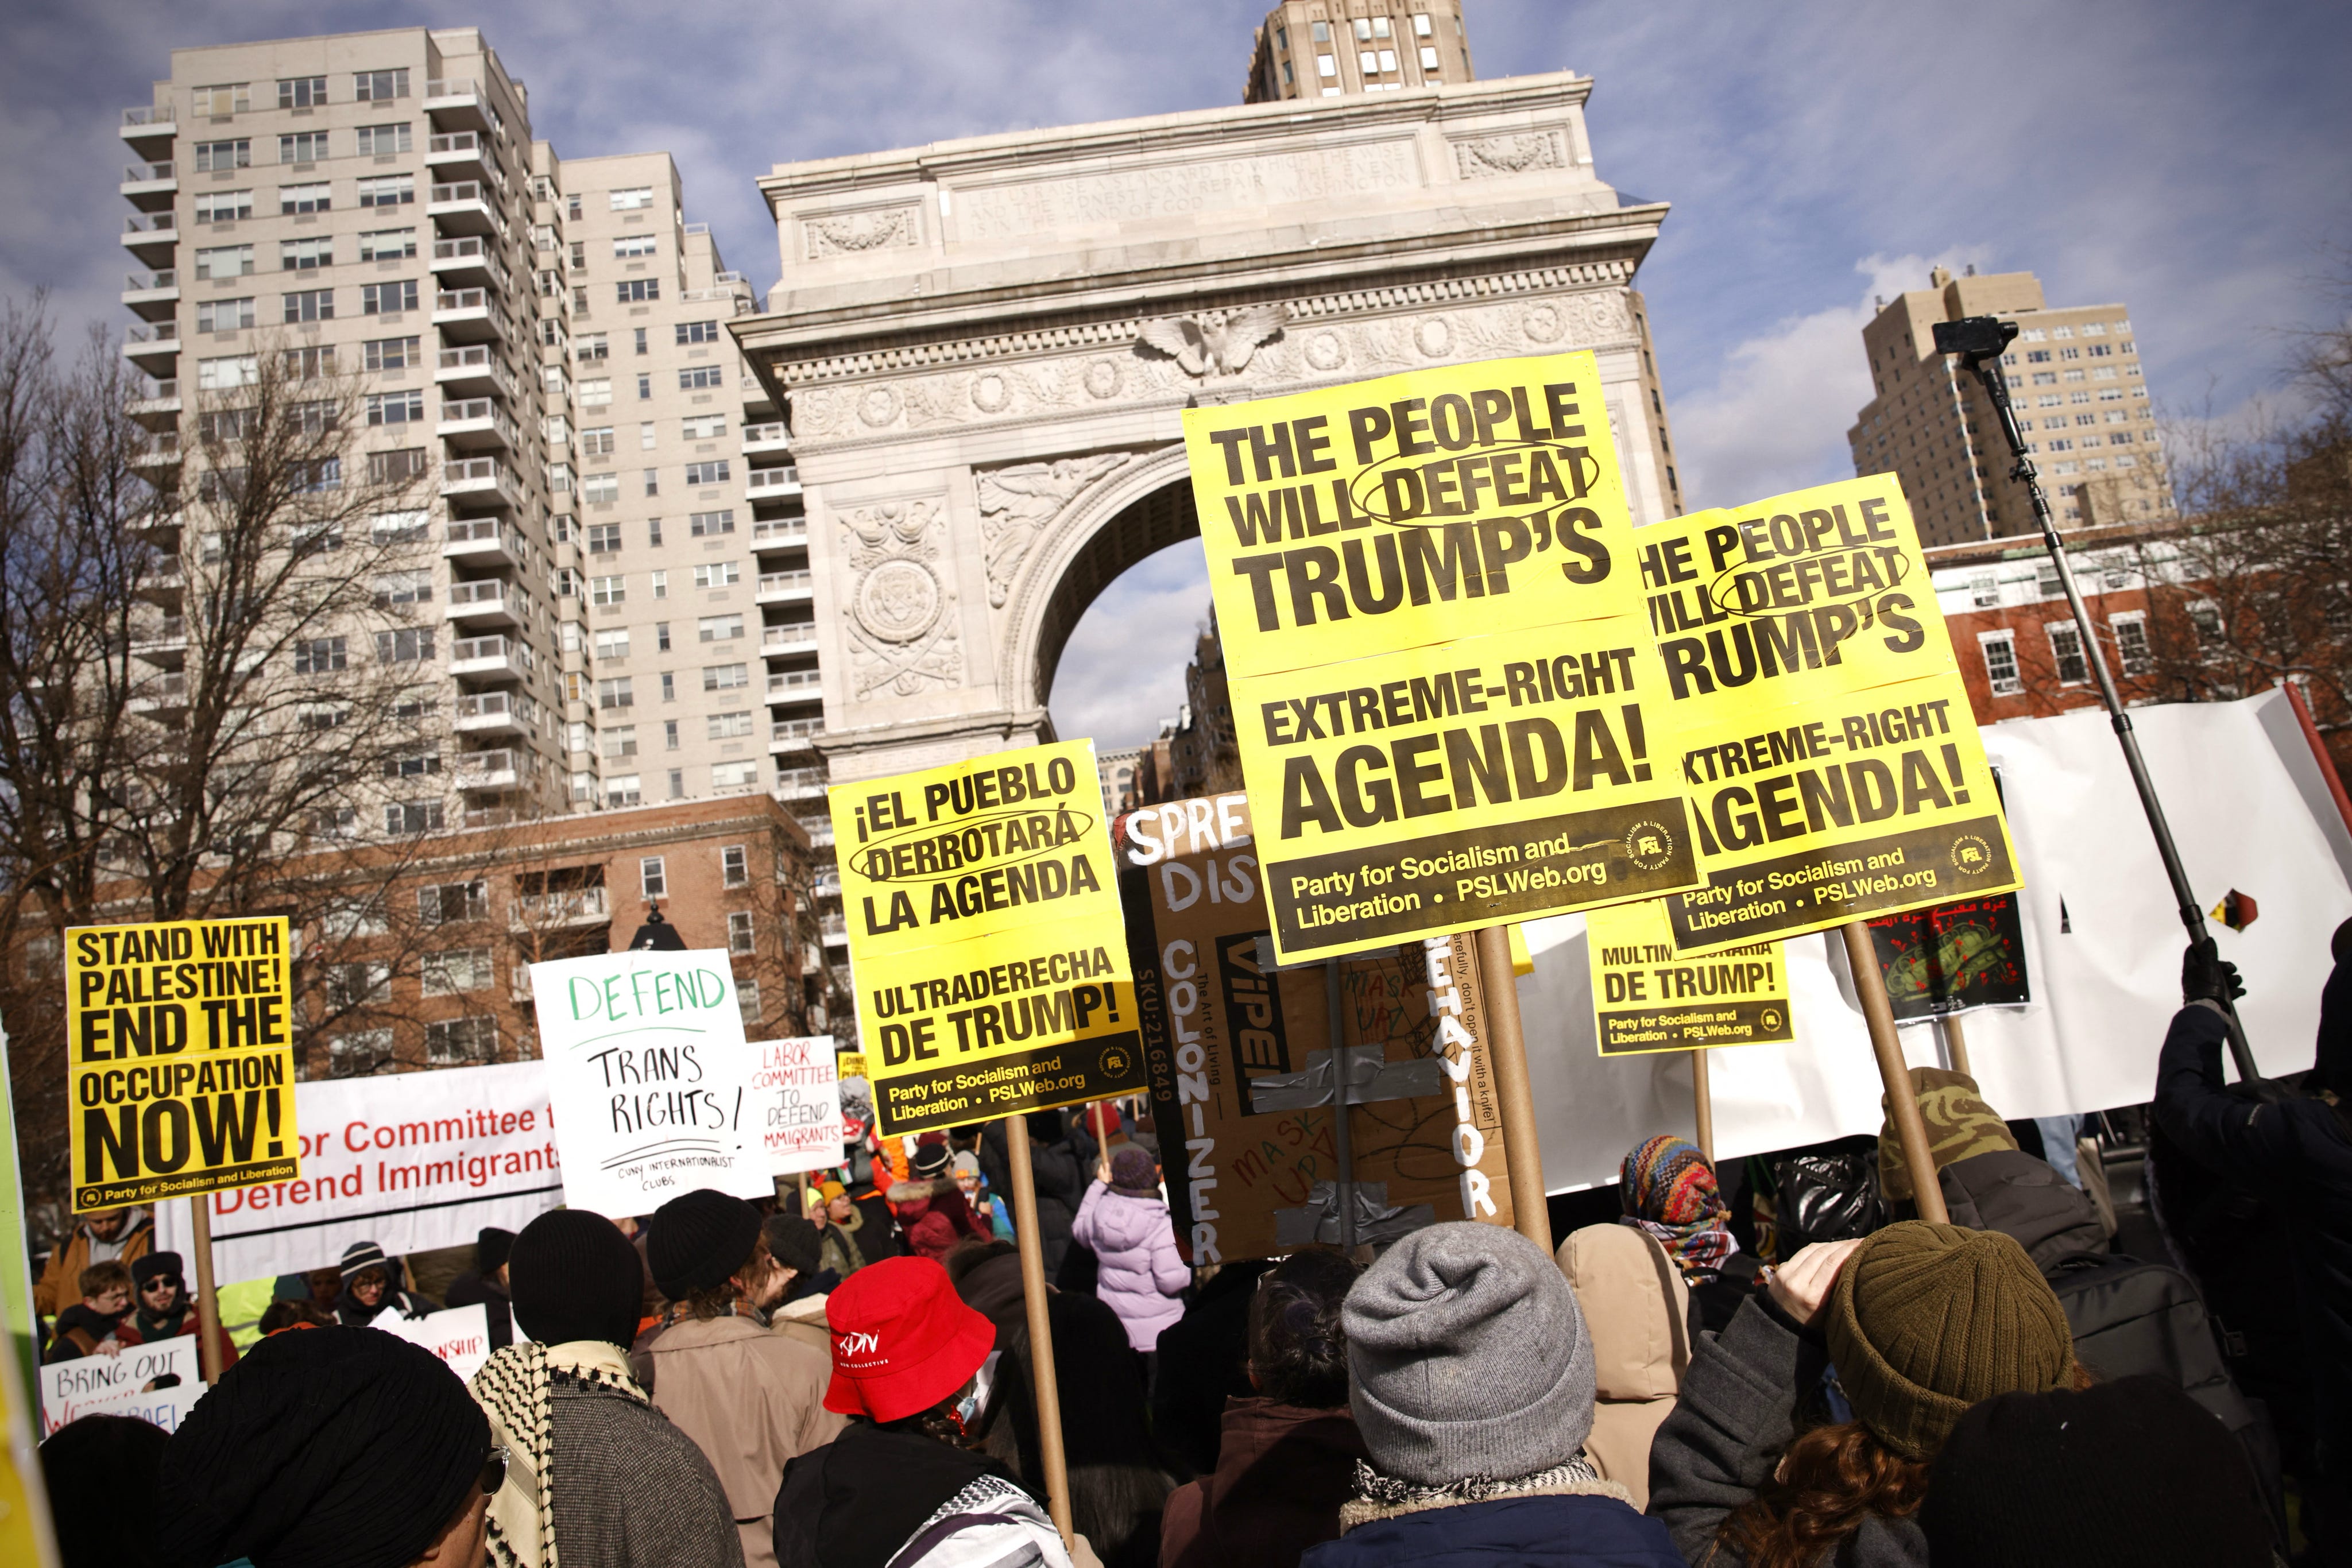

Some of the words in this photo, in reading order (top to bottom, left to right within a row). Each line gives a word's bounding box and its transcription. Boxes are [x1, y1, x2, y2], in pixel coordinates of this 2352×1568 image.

[972, 204, 1007, 221] AND
[1013, 199, 1051, 215] THE
[1062, 189, 1138, 211] HONEST
[1150, 183, 1191, 200] CAN
[1198, 173, 1263, 192] REPAIR
[1295, 167, 1332, 183] THE
[1343, 156, 1406, 177] EVENT
[1034, 178, 1085, 198] RAISE
[1113, 165, 1210, 188] STANDARD
[1221, 162, 1244, 176] TO
[1250, 153, 1312, 173] WHICH
[1317, 149, 1352, 164] THE
[1359, 144, 1404, 159] WISE
[1018, 214, 1057, 230] THE
[1067, 206, 1121, 224] HAND
[1129, 202, 1154, 218] OF
[1163, 195, 1202, 211] GOD
[1282, 173, 1410, 196] WASHINGTON
[1210, 415, 1337, 486] THE
[1348, 382, 1585, 464] PEOPLE
[1225, 478, 1372, 547] WILL
[1382, 447, 1589, 522] DEFEAT
[1637, 536, 1699, 590] HE
[1704, 497, 1895, 573] PEOPLE
[1232, 507, 1612, 632] TRUMP'S
[1733, 546, 1902, 614] DEFEAT
[1659, 593, 1925, 700] RUMP'S
[1261, 647, 1636, 746] EXTREME-RIGHT
[1681, 699, 1951, 786] XTREME-RIGHT
[1281, 703, 1653, 840] AGENDA!
[854, 791, 917, 843] ¡EL
[924, 757, 1076, 822] PUEBLO
[866, 802, 1081, 882] DERROTARÁ
[1126, 796, 1252, 866] SPRE
[1626, 823, 1642, 859] SOCIALISM
[1637, 836, 1662, 856] PSL
[1650, 820, 1673, 856] LIBERATION
[1951, 837, 1964, 866] SOCIALISM
[1970, 835, 1991, 862] LIBERATION
[1291, 869, 1356, 901] Party
[1360, 862, 1395, 886] for
[1401, 845, 1519, 879] Socialism
[1525, 833, 1569, 860] and
[1634, 858, 1647, 870] FOR
[1649, 856, 1669, 870] PARTY
[1682, 882, 1733, 908] Party
[1736, 876, 1766, 897] for
[1768, 860, 1864, 890] Socialism
[1867, 847, 1905, 869] and
[1958, 865, 1970, 874] FOR
[1960, 847, 1983, 864] PSL
[1972, 862, 1989, 875] PARTY
[862, 890, 920, 936] LA
[929, 854, 1101, 925] AGENDA
[1161, 855, 1258, 912] DIS
[1296, 892, 1420, 930] Liberation
[1456, 861, 1607, 902] PSLWeb.org
[1687, 898, 1786, 932] Liberation
[1815, 868, 1937, 905] PSLWeb.org
[78, 927, 192, 967] STAND
[201, 923, 279, 958] WITH
[1453, 933, 1468, 979] arefully,
[80, 959, 280, 1008] PALESTINE!
[568, 968, 725, 1021] DEFEND
[873, 946, 1115, 1019] ULTRADERECHA
[1197, 973, 1209, 997] The
[1345, 970, 1415, 999] MASK
[1461, 982, 1476, 1012] don't
[1604, 971, 1647, 1004] DE
[1654, 962, 1775, 1000] TRUMP!
[80, 1004, 187, 1062] END
[201, 996, 285, 1050] THE
[879, 1019, 939, 1067] DE
[947, 982, 1119, 1056] TRUMP!
[1138, 969, 1172, 1102] SKU:216849
[1201, 1002, 1213, 1022] Art
[1205, 1026, 1217, 1040] of
[1467, 1013, 1478, 1043] open
[1608, 1017, 1638, 1032] Party
[1641, 1016, 1657, 1027] for
[1658, 1012, 1714, 1026] Socialism
[1716, 1010, 1737, 1021] and
[1610, 1030, 1668, 1044] Liberation
[1683, 1024, 1753, 1039] PSLWeb.org
[587, 1045, 703, 1088] TRANS
[764, 1040, 811, 1069] LABOR
[1472, 1045, 1482, 1053] it
[1474, 1055, 1486, 1079] with
[79, 1054, 284, 1107] OCCUPATION
[752, 1064, 834, 1090] COMMITTEE
[776, 1089, 800, 1109] TO
[888, 1077, 929, 1104] Party
[932, 1071, 953, 1094] for
[956, 1065, 1030, 1090] Socialism
[1031, 1056, 1062, 1075] and
[891, 1095, 968, 1122] Liberation
[989, 1070, 1086, 1103] PSLWeb.org
[1478, 1081, 1486, 1089] a
[768, 1101, 829, 1126] DEFEND
[1162, 939, 1222, 1266] COLONIZER
[1480, 1090, 1495, 1122] knife!
[84, 1088, 284, 1184] NOW!
[345, 1109, 535, 1153] Committee
[546, 1102, 554, 1129] t
[764, 1125, 840, 1149] MMIGRANTS
[1231, 1110, 1324, 1188] MASK
[105, 1187, 137, 1201] Party
[140, 1183, 157, 1195] for
[160, 1177, 215, 1194] Socialism
[217, 1172, 237, 1184] and
[240, 1164, 293, 1181] Liberation
[215, 1165, 362, 1216] Defend
[618, 1164, 644, 1180] CUNY
[649, 1156, 735, 1172] INTERNATIONALIST
[643, 1177, 675, 1191] CLUBS
[1272, 1153, 1317, 1205] UP
[57, 1362, 127, 1399] BRING
[136, 1349, 181, 1379] OUT
[851, 1358, 889, 1369] COLLECTIVE
